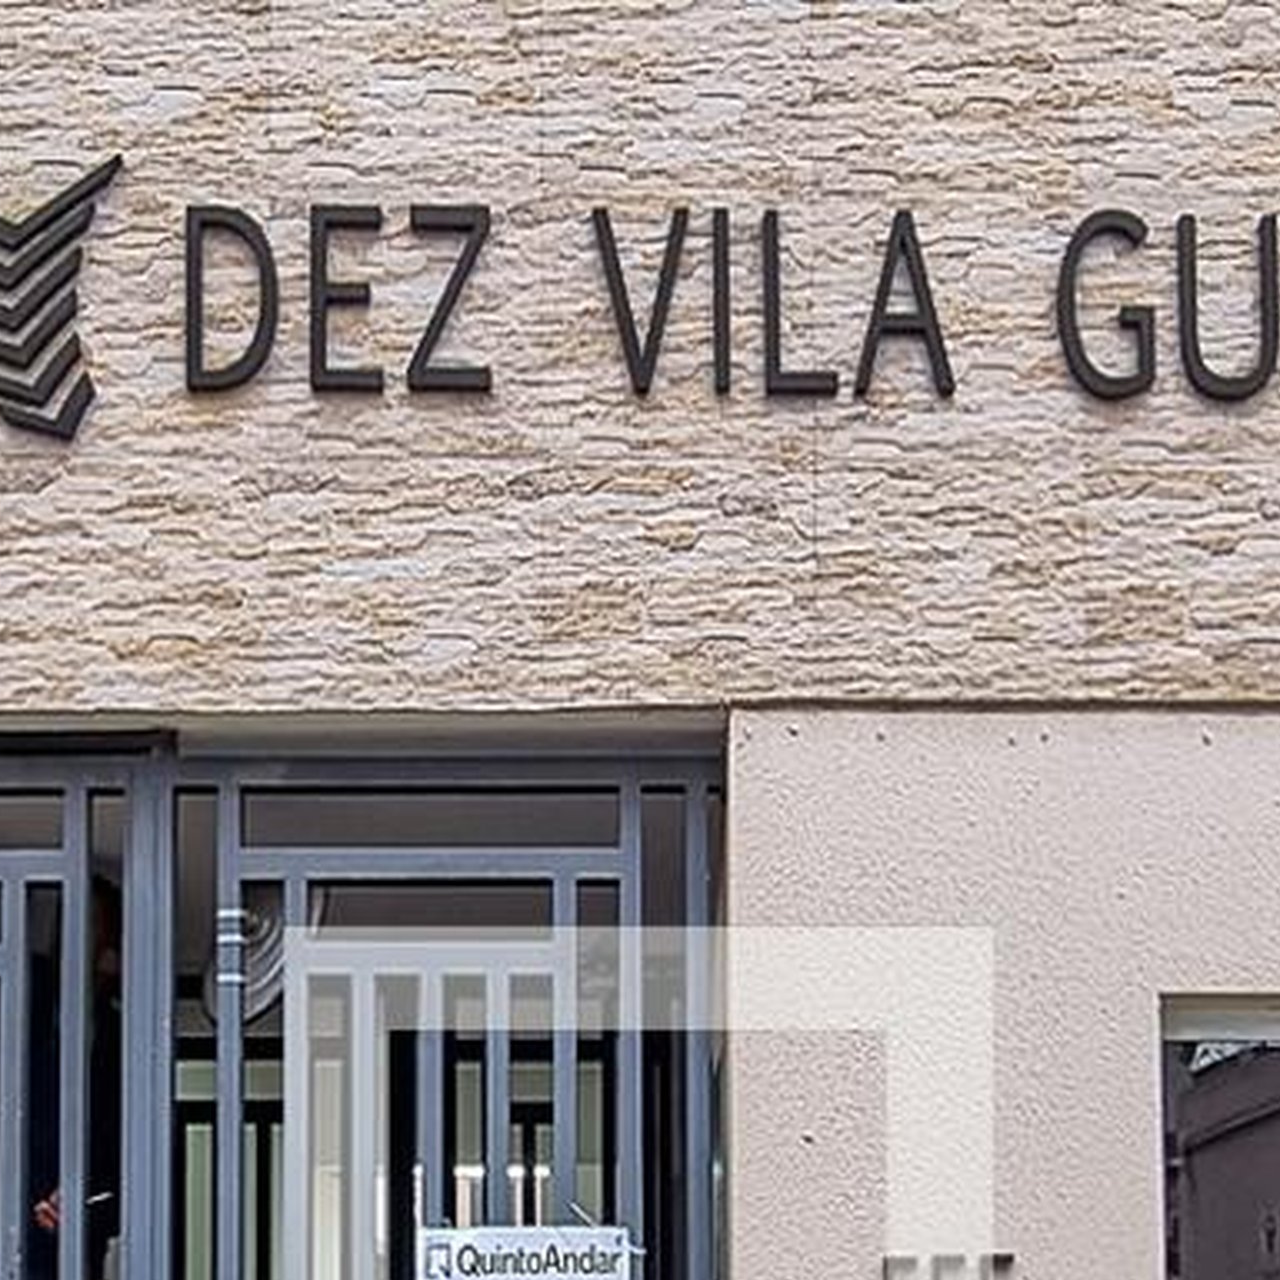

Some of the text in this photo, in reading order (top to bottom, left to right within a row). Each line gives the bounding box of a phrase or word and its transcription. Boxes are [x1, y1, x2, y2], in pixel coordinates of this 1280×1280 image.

[184, 204, 493, 396] DEZ
[592, 207, 957, 399] VILA
[456, 1243, 620, 1278] QuintoAndar
